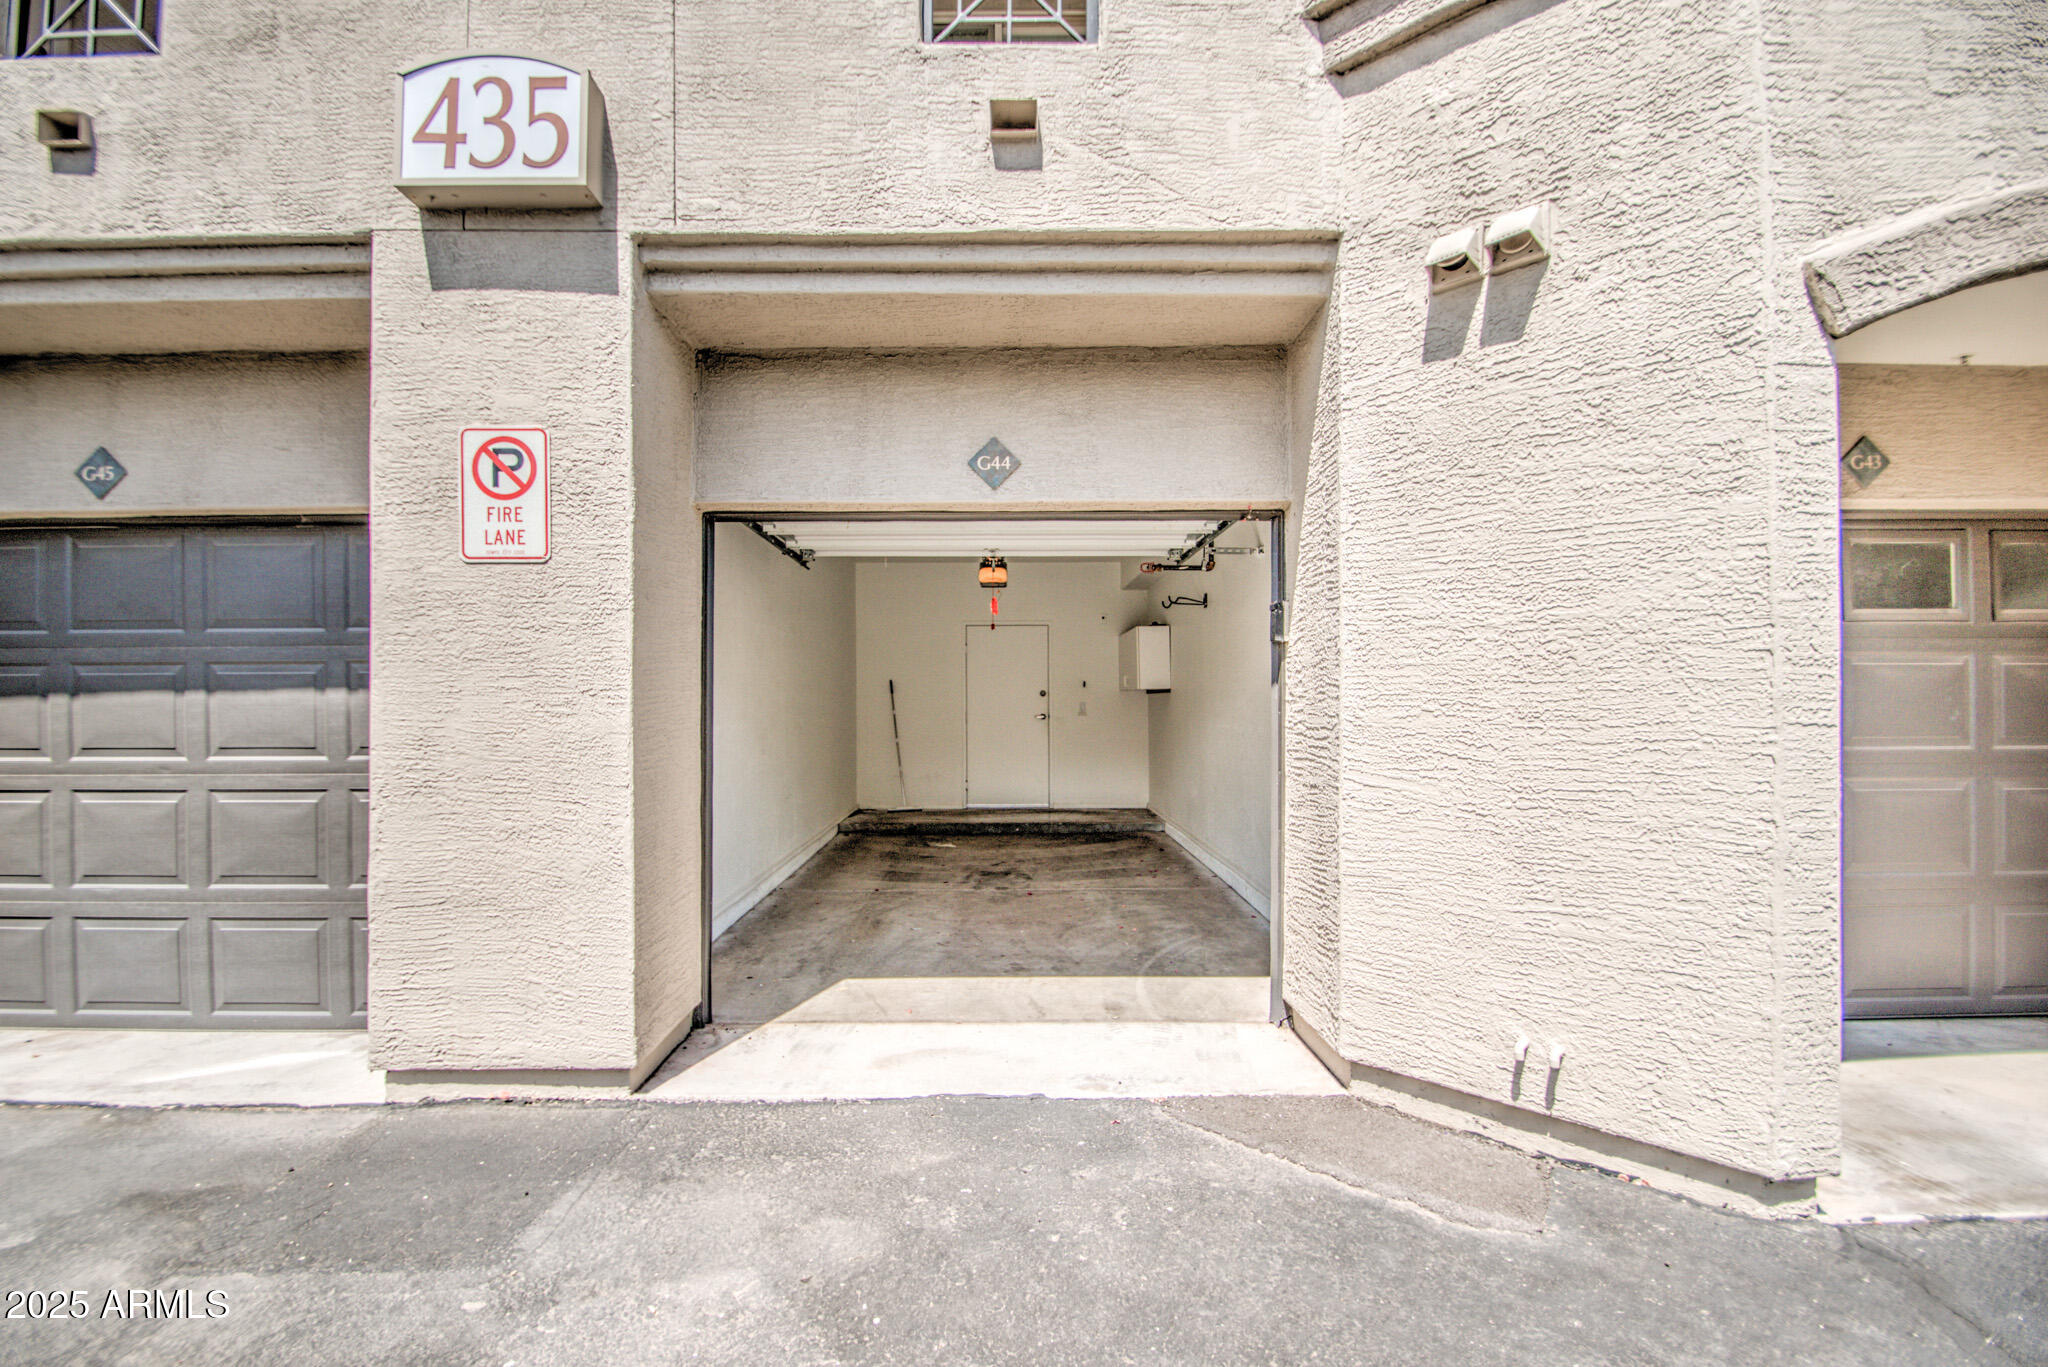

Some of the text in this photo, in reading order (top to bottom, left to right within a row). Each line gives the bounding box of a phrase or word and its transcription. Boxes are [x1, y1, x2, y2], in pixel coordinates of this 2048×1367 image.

[412, 75, 570, 170] 435
[491, 447, 525, 488] P
[976, 455, 1011, 471] G44
[81, 465, 115, 482] G45
[486, 506, 524, 523] FIRE
[484, 529, 526, 546] LANE
